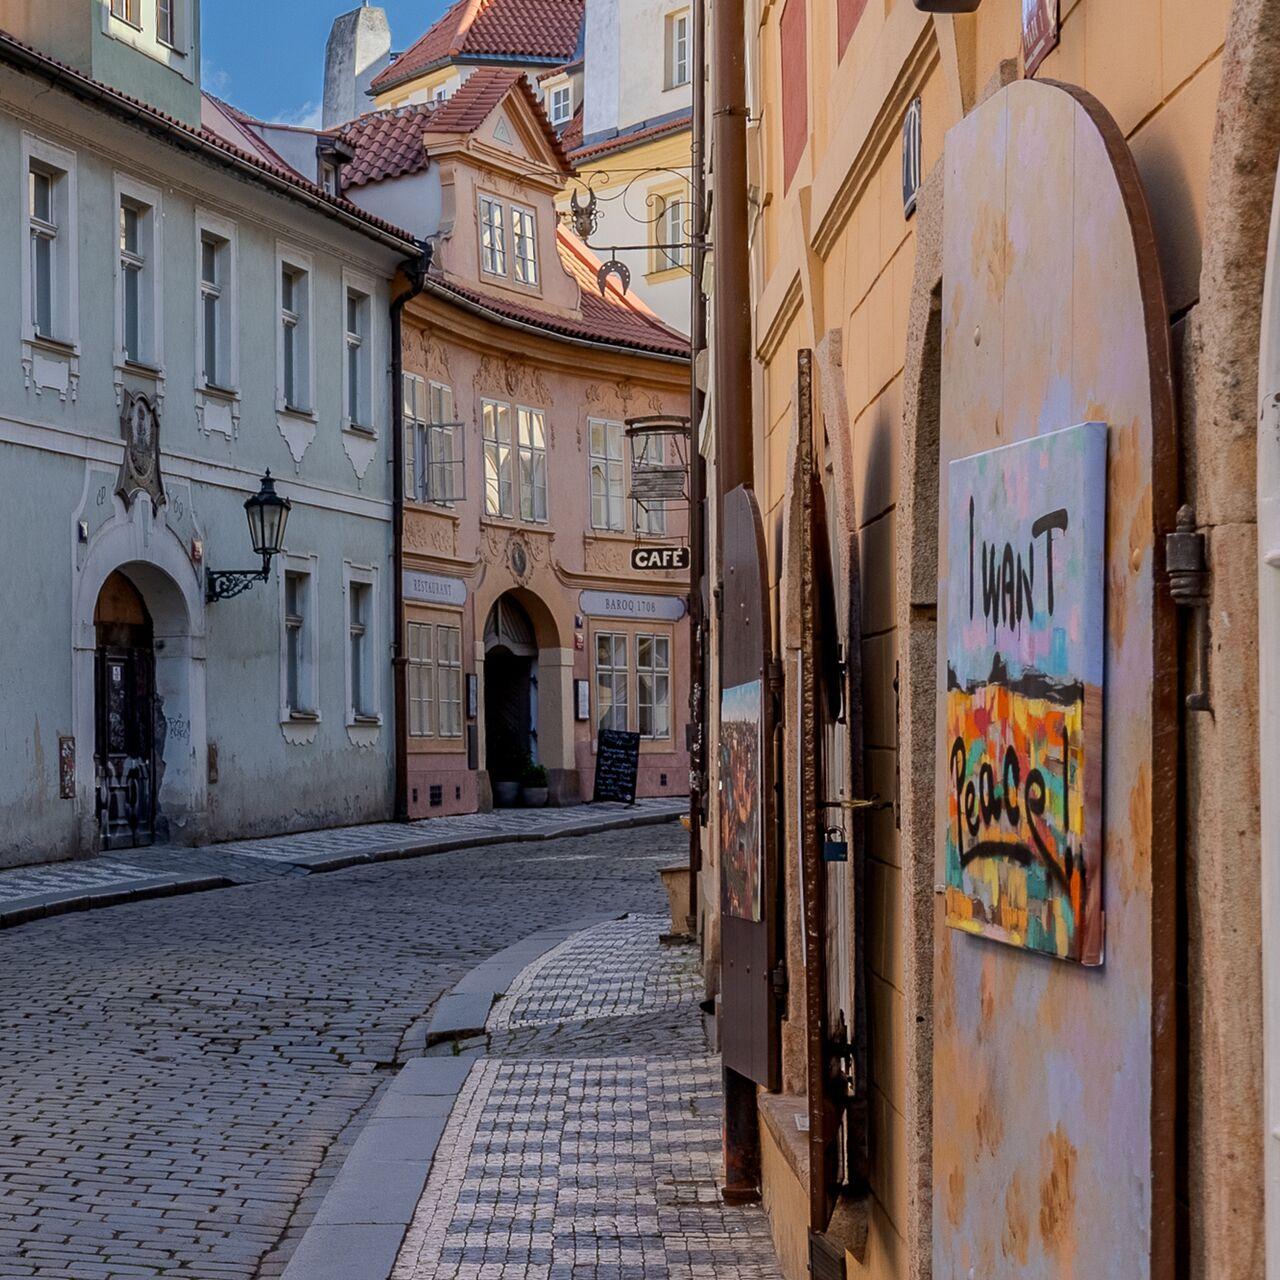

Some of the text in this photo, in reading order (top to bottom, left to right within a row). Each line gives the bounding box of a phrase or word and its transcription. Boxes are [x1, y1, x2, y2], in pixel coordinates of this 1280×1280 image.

[635, 548, 683, 567] CAFÉ
[968, 495, 1068, 634] I WANT
[605, 599, 634, 612] BAROQ
